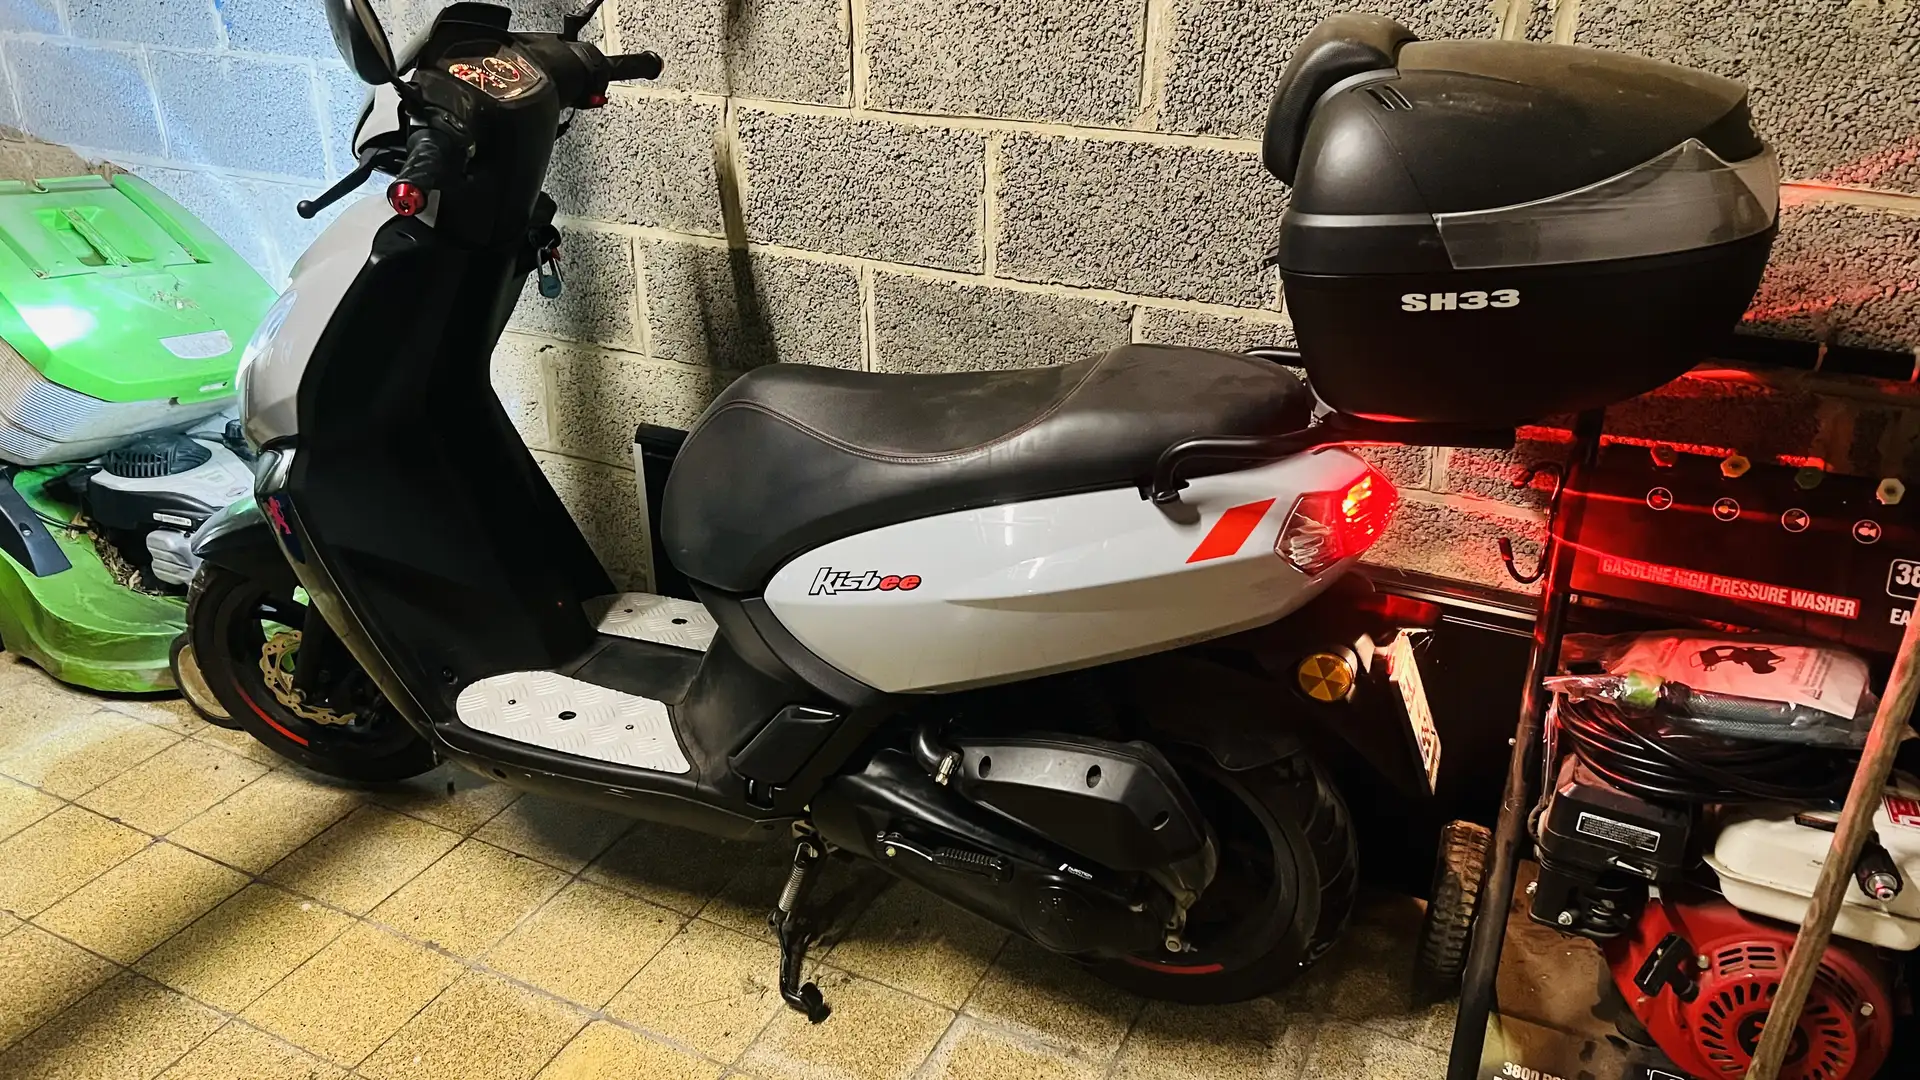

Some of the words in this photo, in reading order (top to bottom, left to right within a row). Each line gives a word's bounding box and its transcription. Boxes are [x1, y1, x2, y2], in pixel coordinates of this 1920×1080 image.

[1401, 289, 1520, 312] SH33
[808, 567, 922, 595] Kisbee
[1602, 558, 1672, 583] GASOLINE
[1673, 569, 1708, 590] HIGH
[1710, 576, 1788, 604] PRESSURE
[1791, 590, 1856, 617] WASHER
